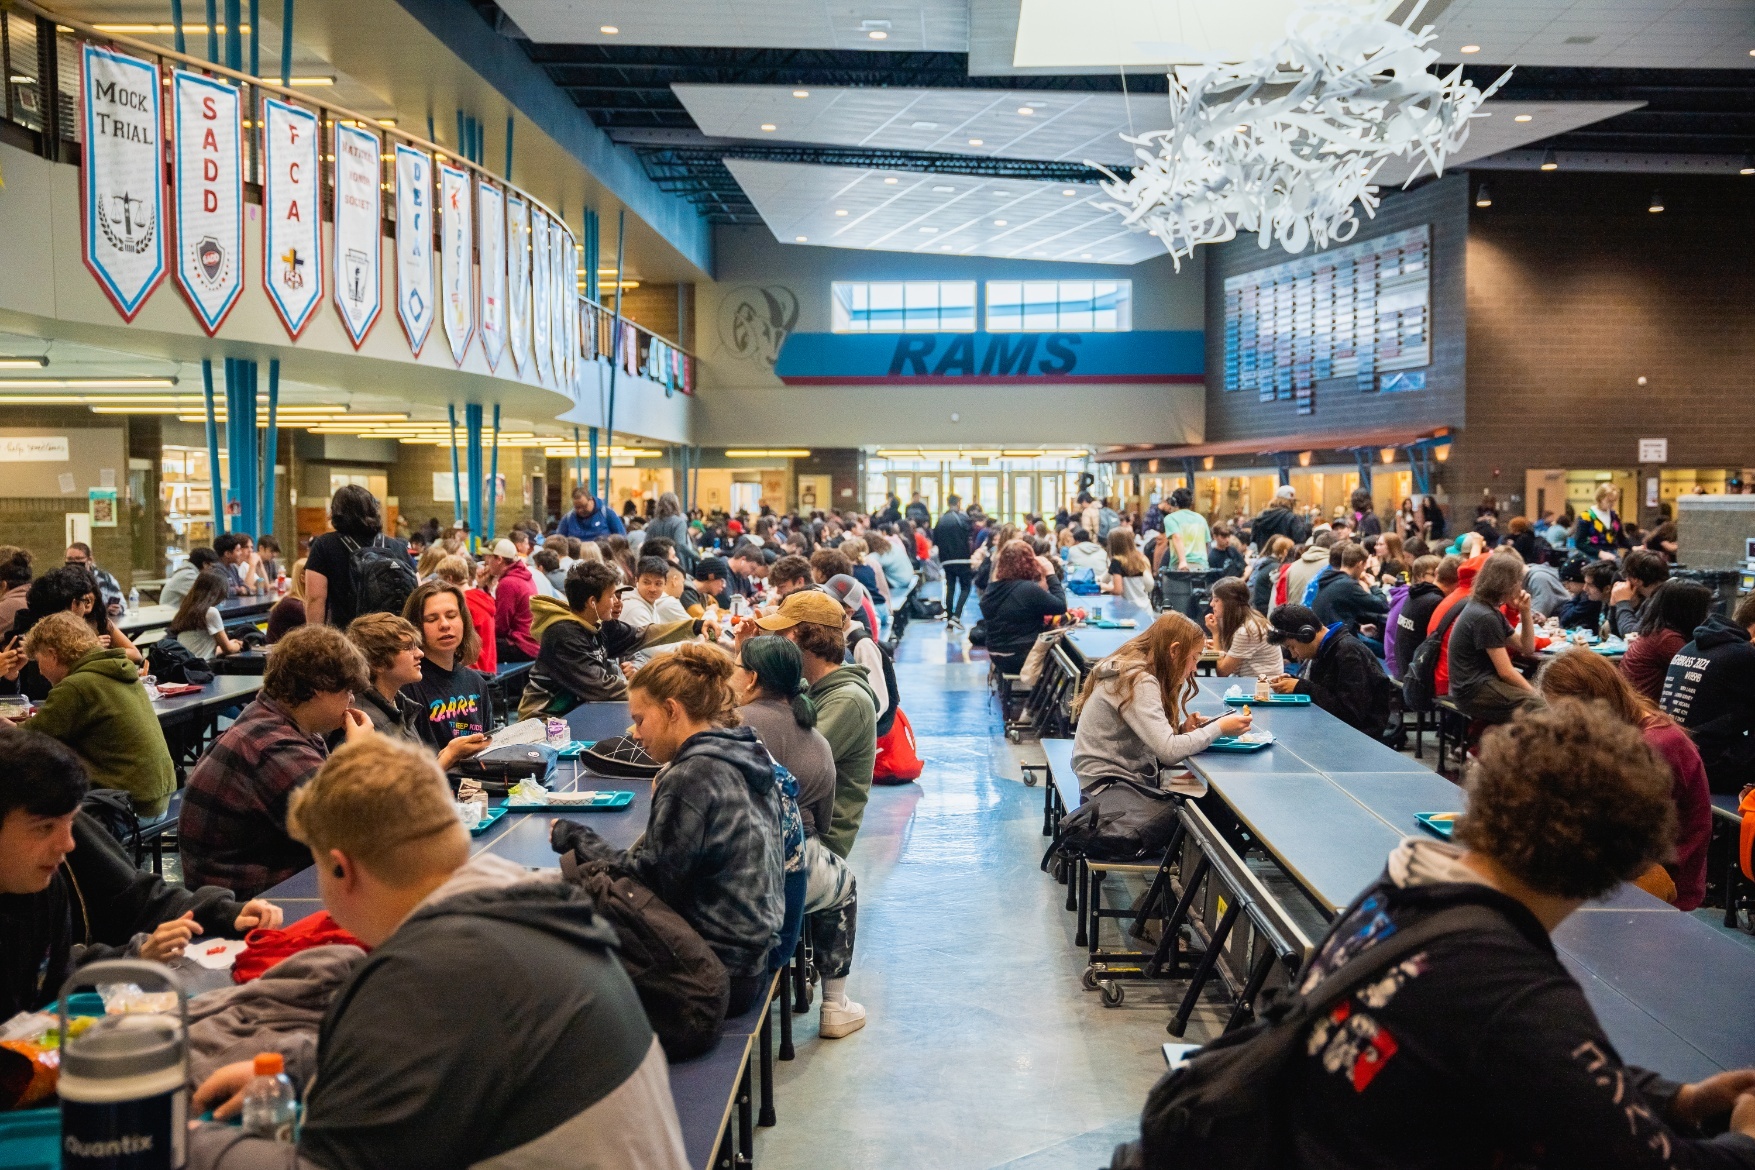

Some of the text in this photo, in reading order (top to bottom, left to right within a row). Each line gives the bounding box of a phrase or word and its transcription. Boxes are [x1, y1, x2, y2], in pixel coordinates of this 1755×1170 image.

[202, 96, 219, 213] SADD
[287, 123, 301, 222] FCA
[888, 332, 1083, 377] RAMS
[65, 1135, 153, 1157] Quantix
